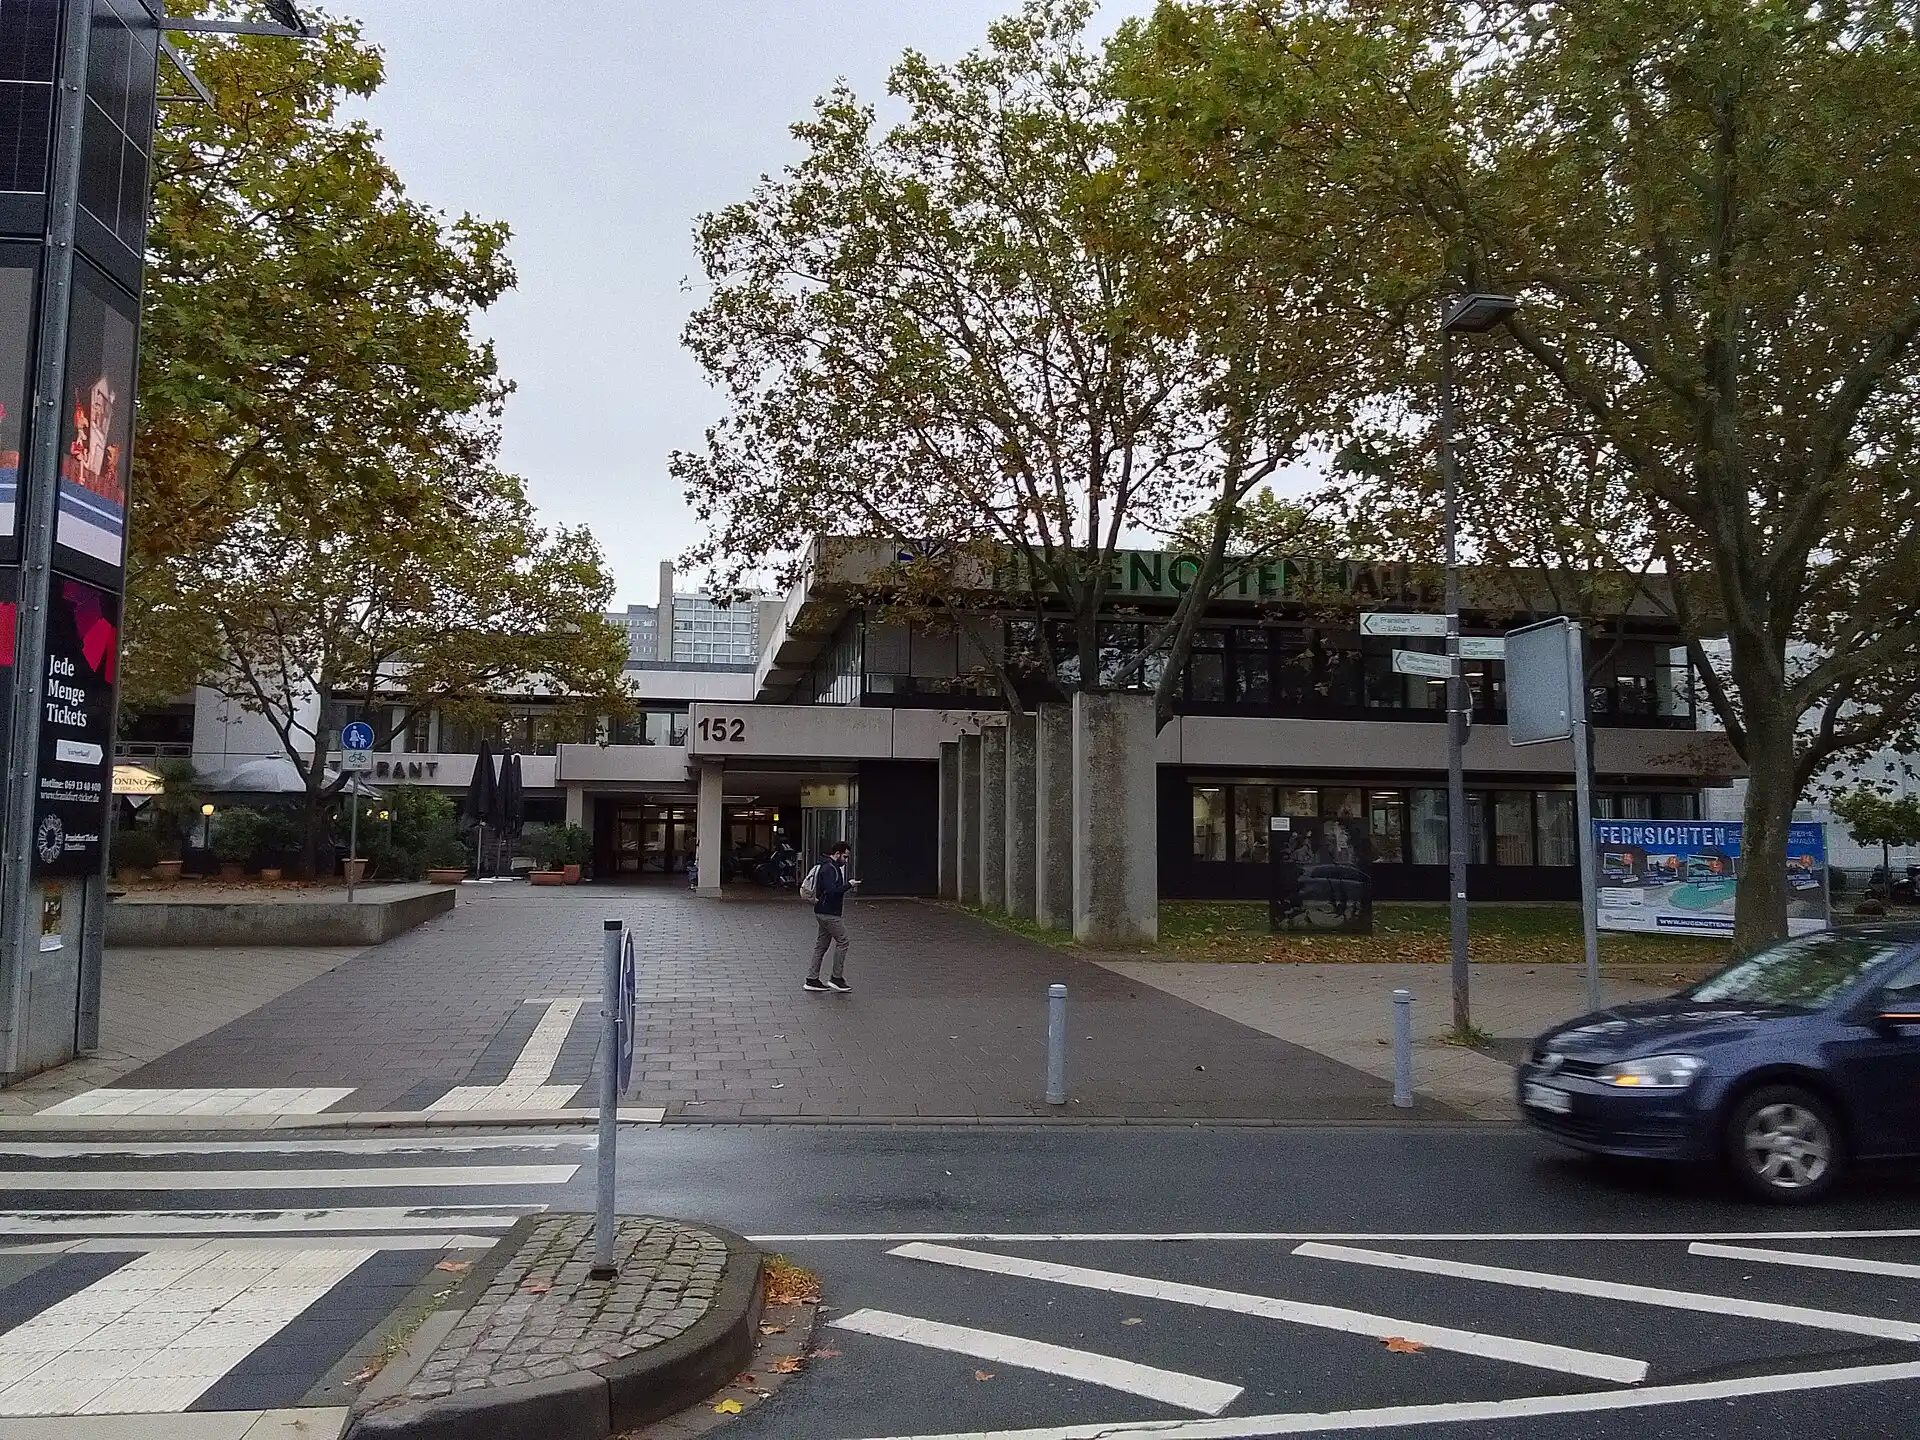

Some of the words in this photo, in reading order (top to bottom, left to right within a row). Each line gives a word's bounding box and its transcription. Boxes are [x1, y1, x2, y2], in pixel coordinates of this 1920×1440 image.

[48, 654, 75, 677] Jede
[47, 678, 85, 706] Menge
[46, 702, 87, 727] Tickets
[698, 717, 745, 742] 152
[114, 778, 148, 786] ONINO
[1600, 826, 1725, 846] FERNSICHTEN
